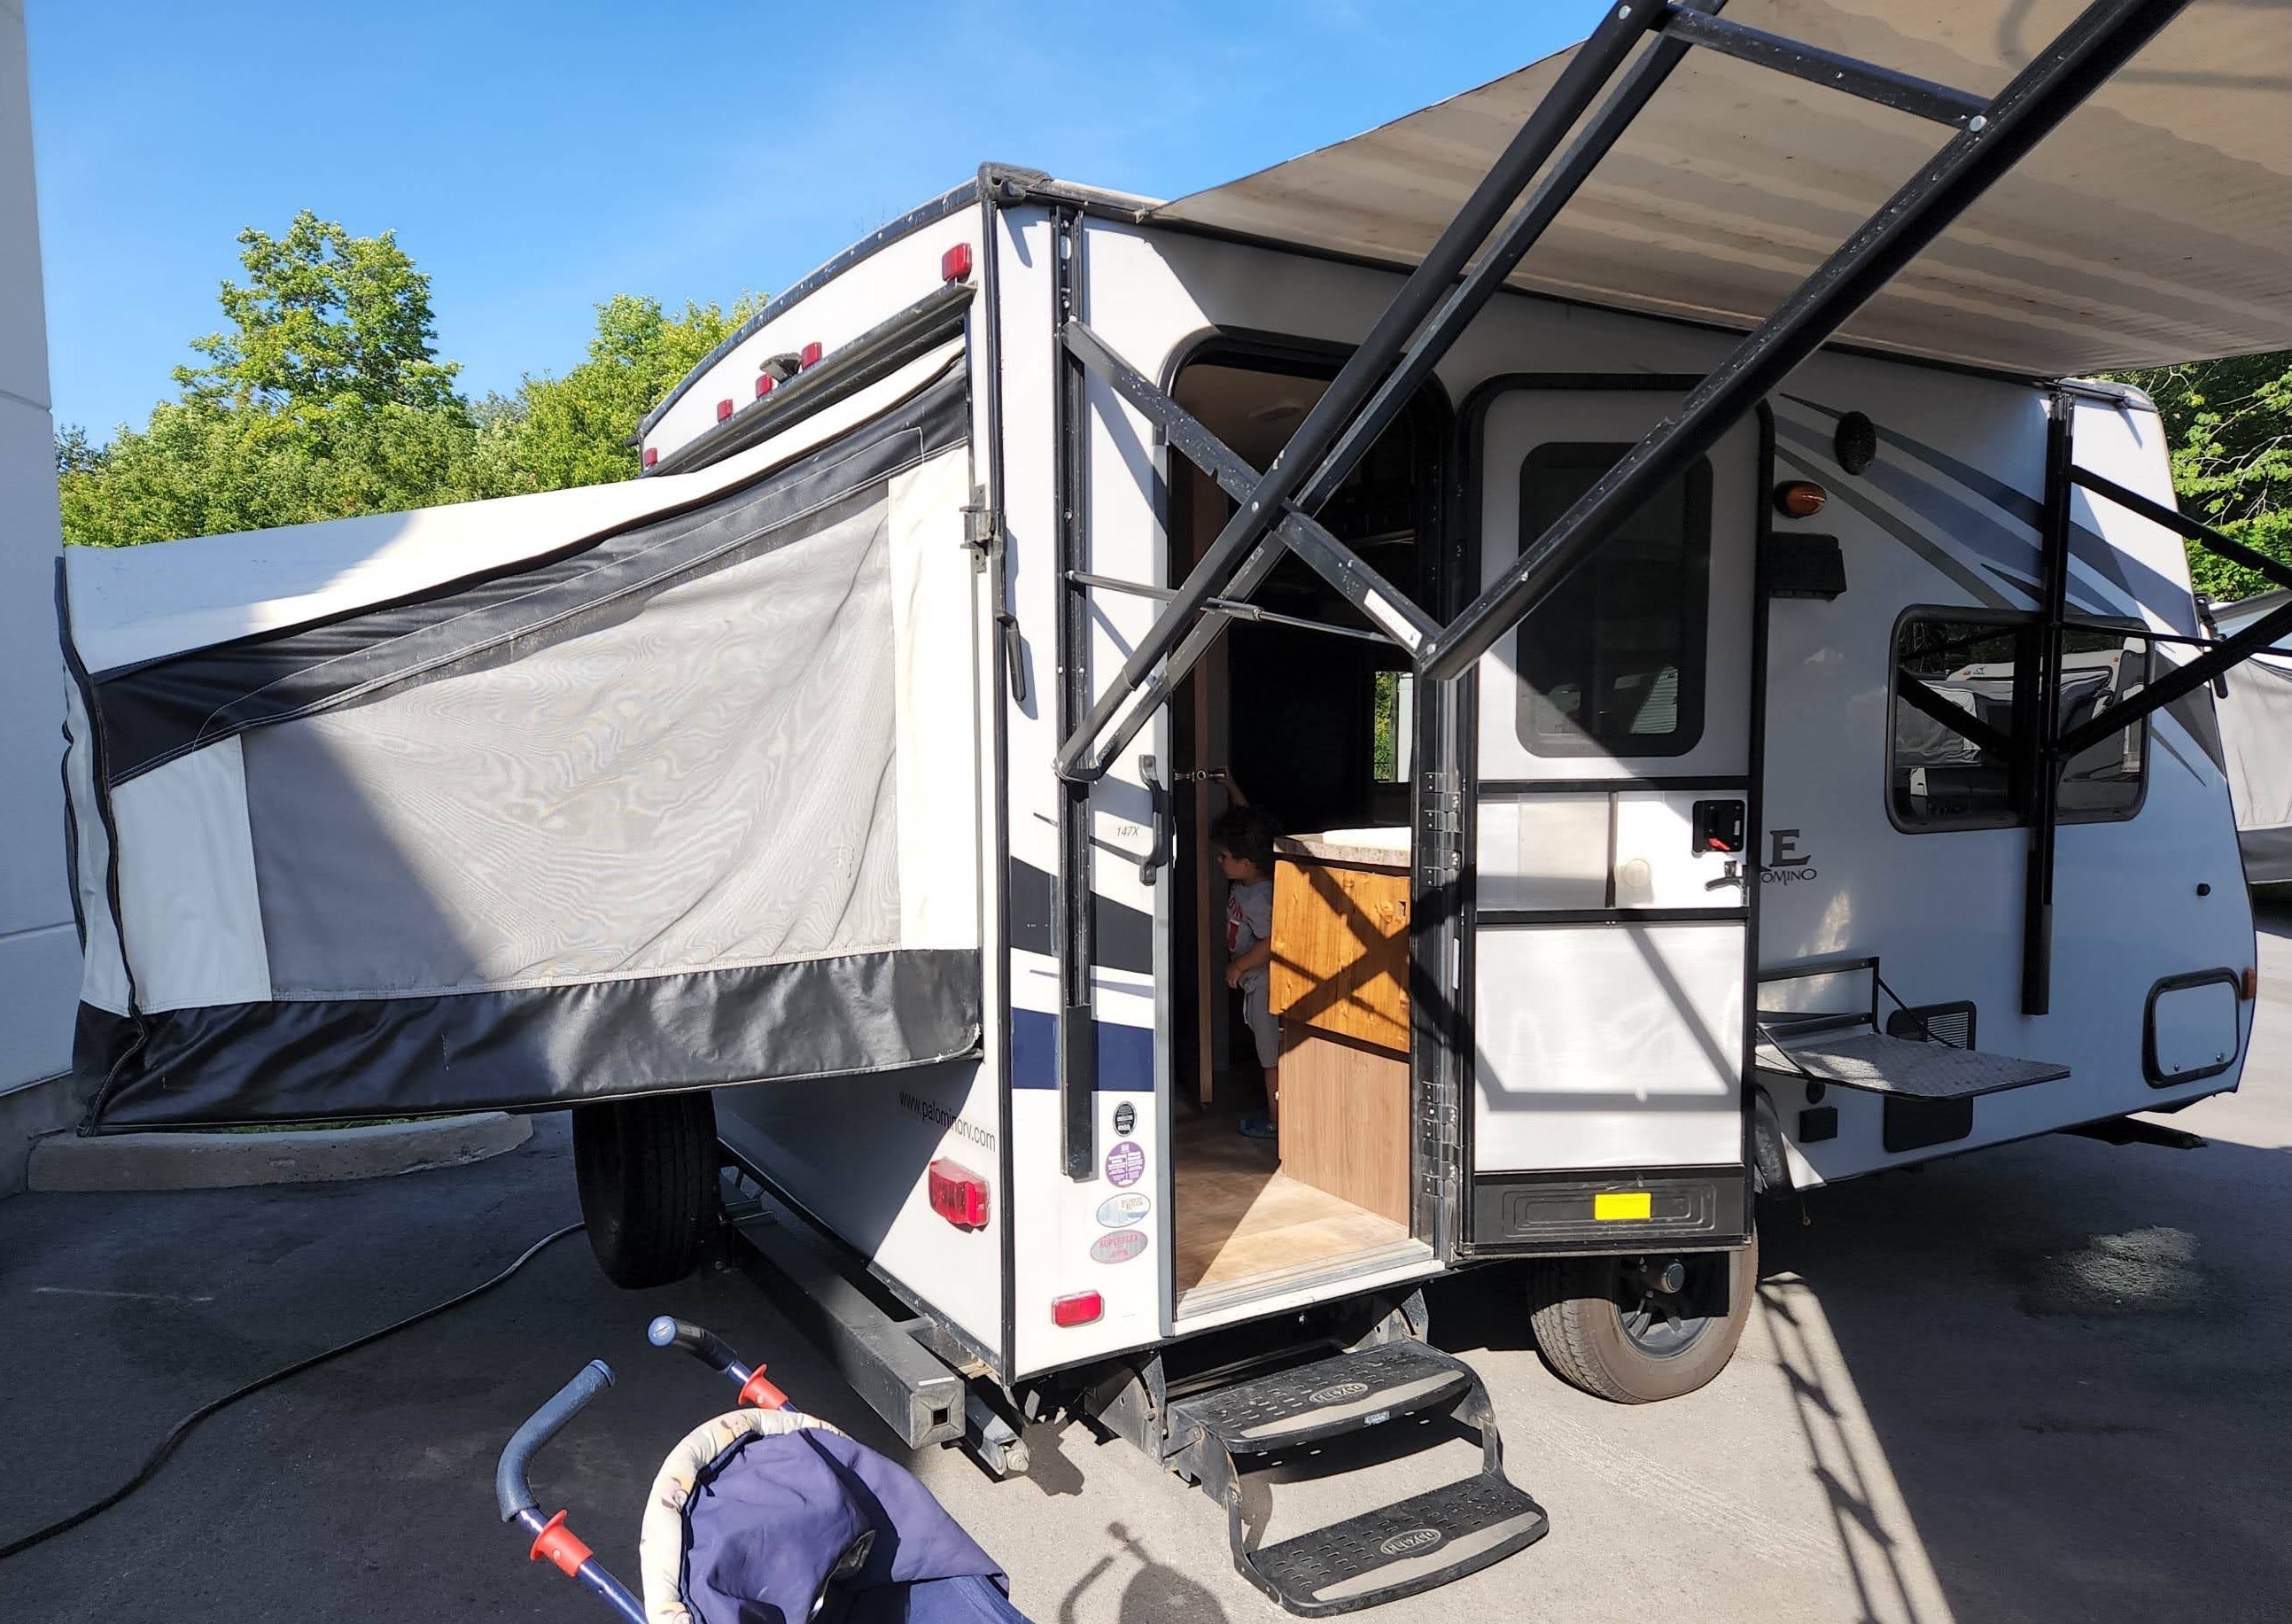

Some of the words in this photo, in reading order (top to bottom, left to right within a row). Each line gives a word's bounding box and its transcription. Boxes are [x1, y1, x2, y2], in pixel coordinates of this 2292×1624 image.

[1117, 825, 1139, 837] 147X
[1761, 828, 1812, 872] E
[899, 1091, 997, 1153] www.palominorv.com
